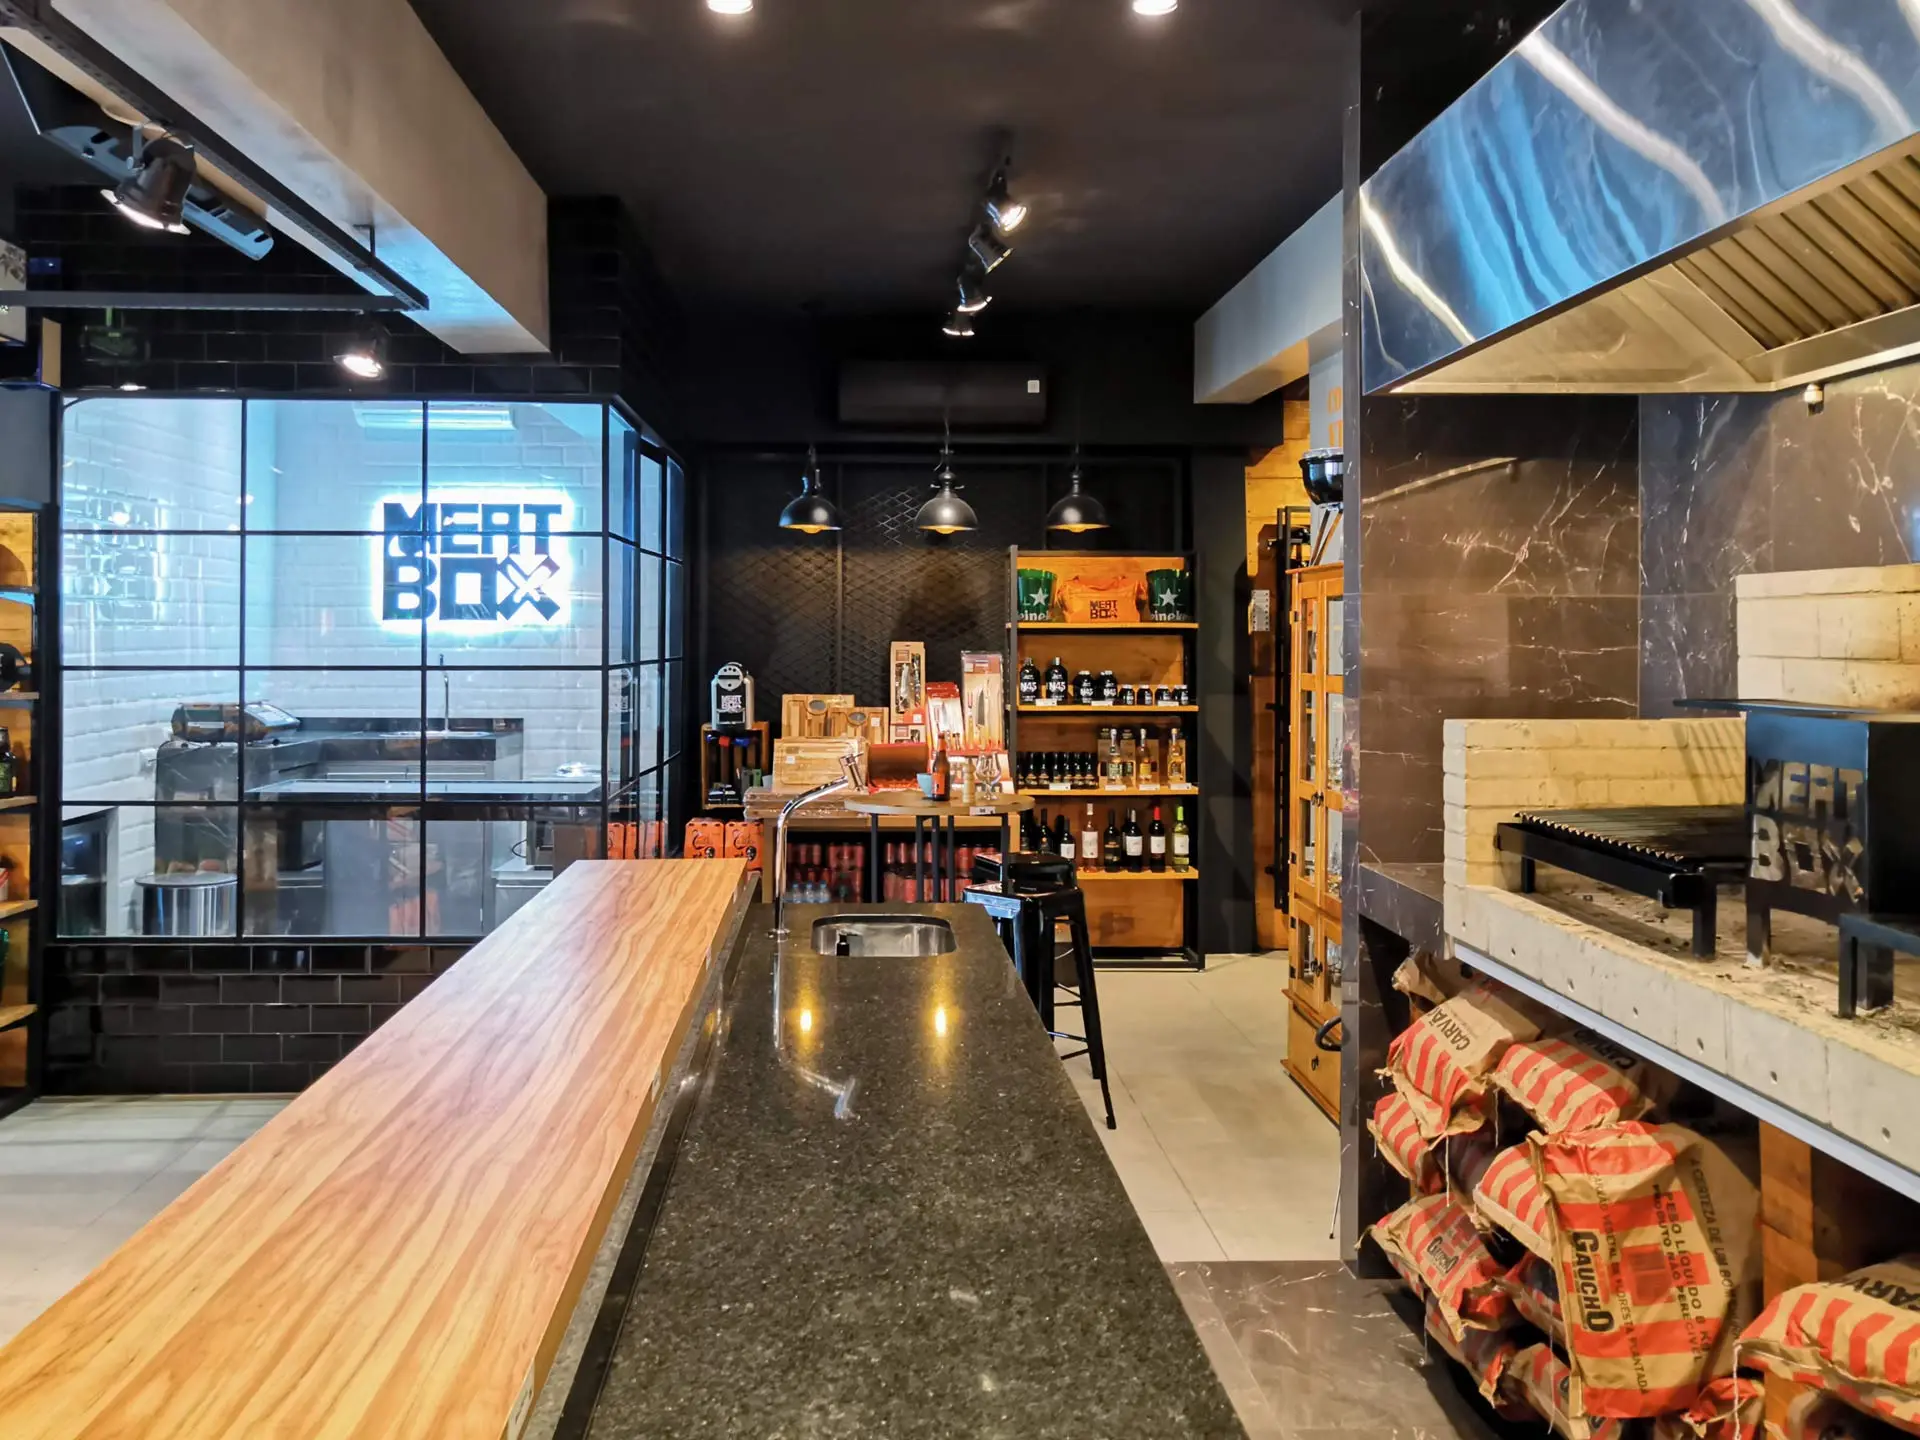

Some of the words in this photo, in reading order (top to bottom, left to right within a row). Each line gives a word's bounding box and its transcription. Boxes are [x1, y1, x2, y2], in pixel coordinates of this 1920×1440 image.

[383, 503, 562, 556] MEAT
[383, 555, 561, 621] BOX
[1751, 758, 1864, 819] MEAT
[1750, 814, 1864, 904] BOX
[1572, 1231, 1615, 1333] GAUCHO
